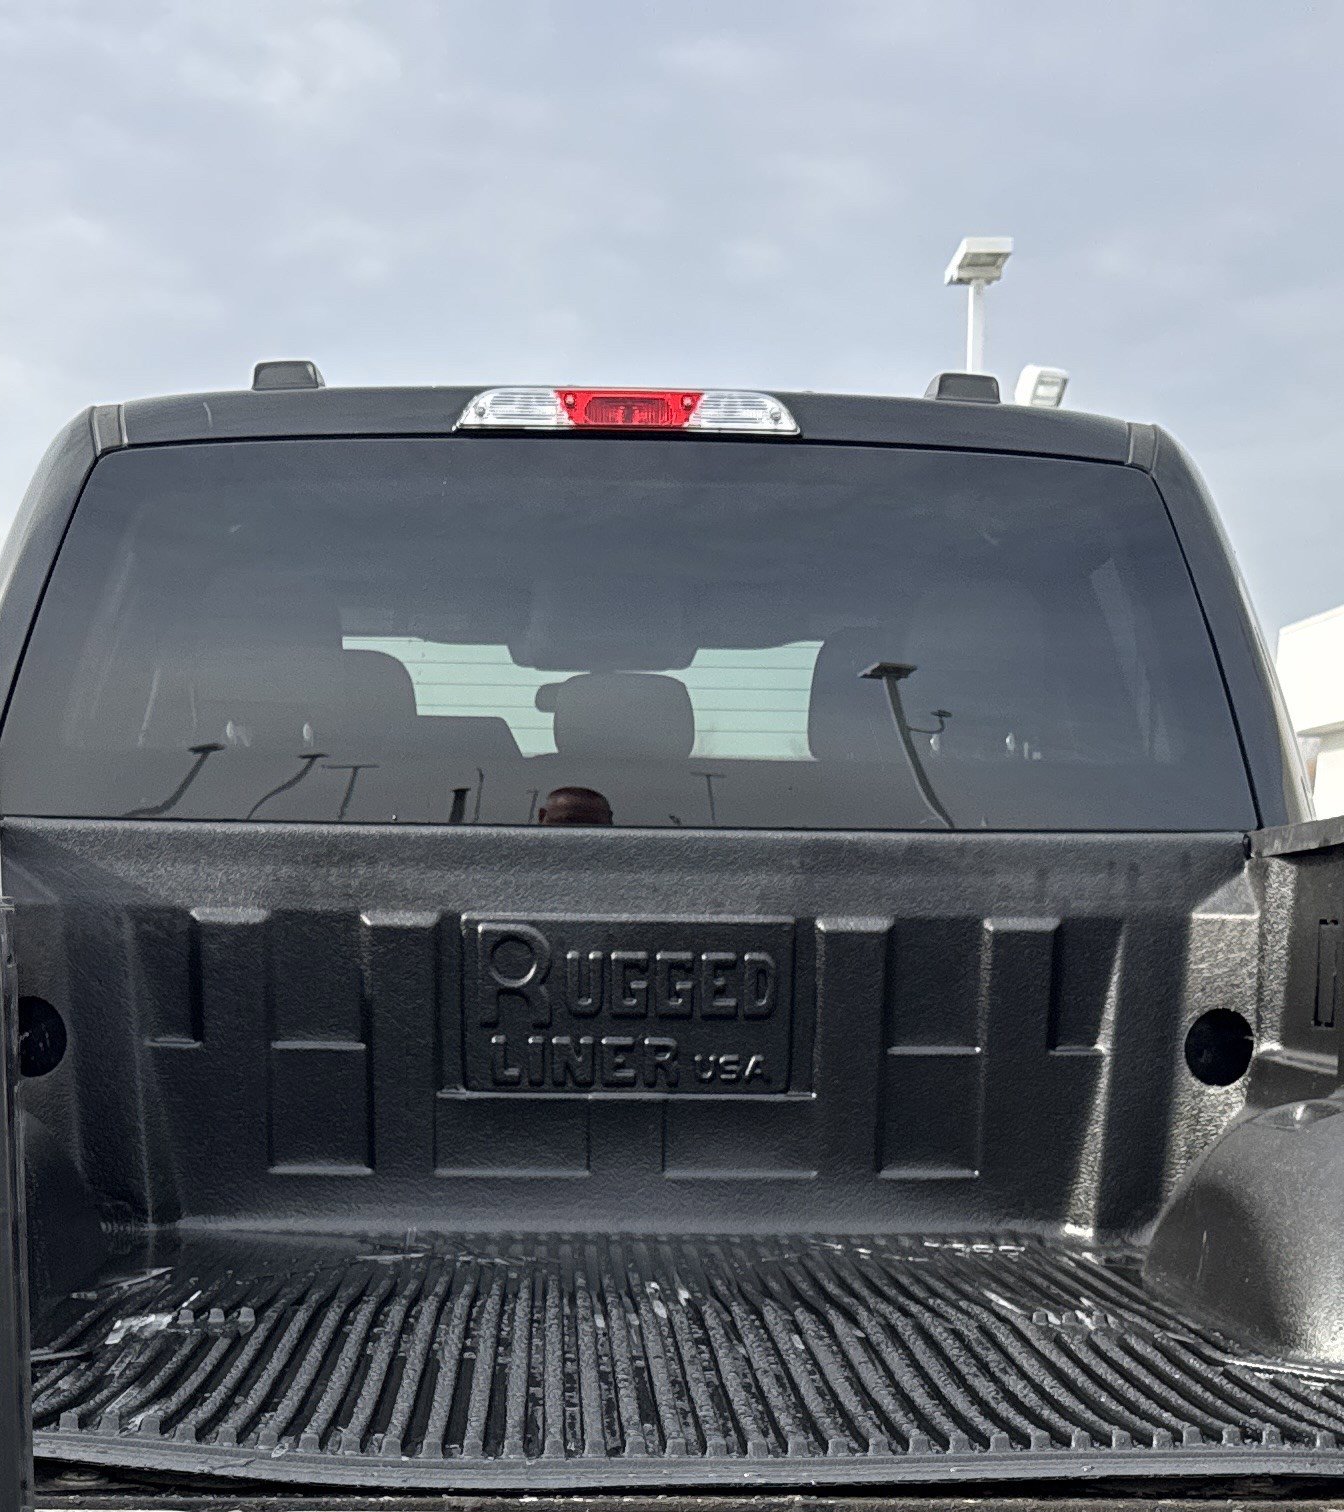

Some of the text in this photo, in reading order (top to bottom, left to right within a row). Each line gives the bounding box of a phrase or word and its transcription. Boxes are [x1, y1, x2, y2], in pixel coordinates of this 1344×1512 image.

[478, 922, 778, 1029] RUGGED
[490, 1035, 771, 1088] LINER USA
